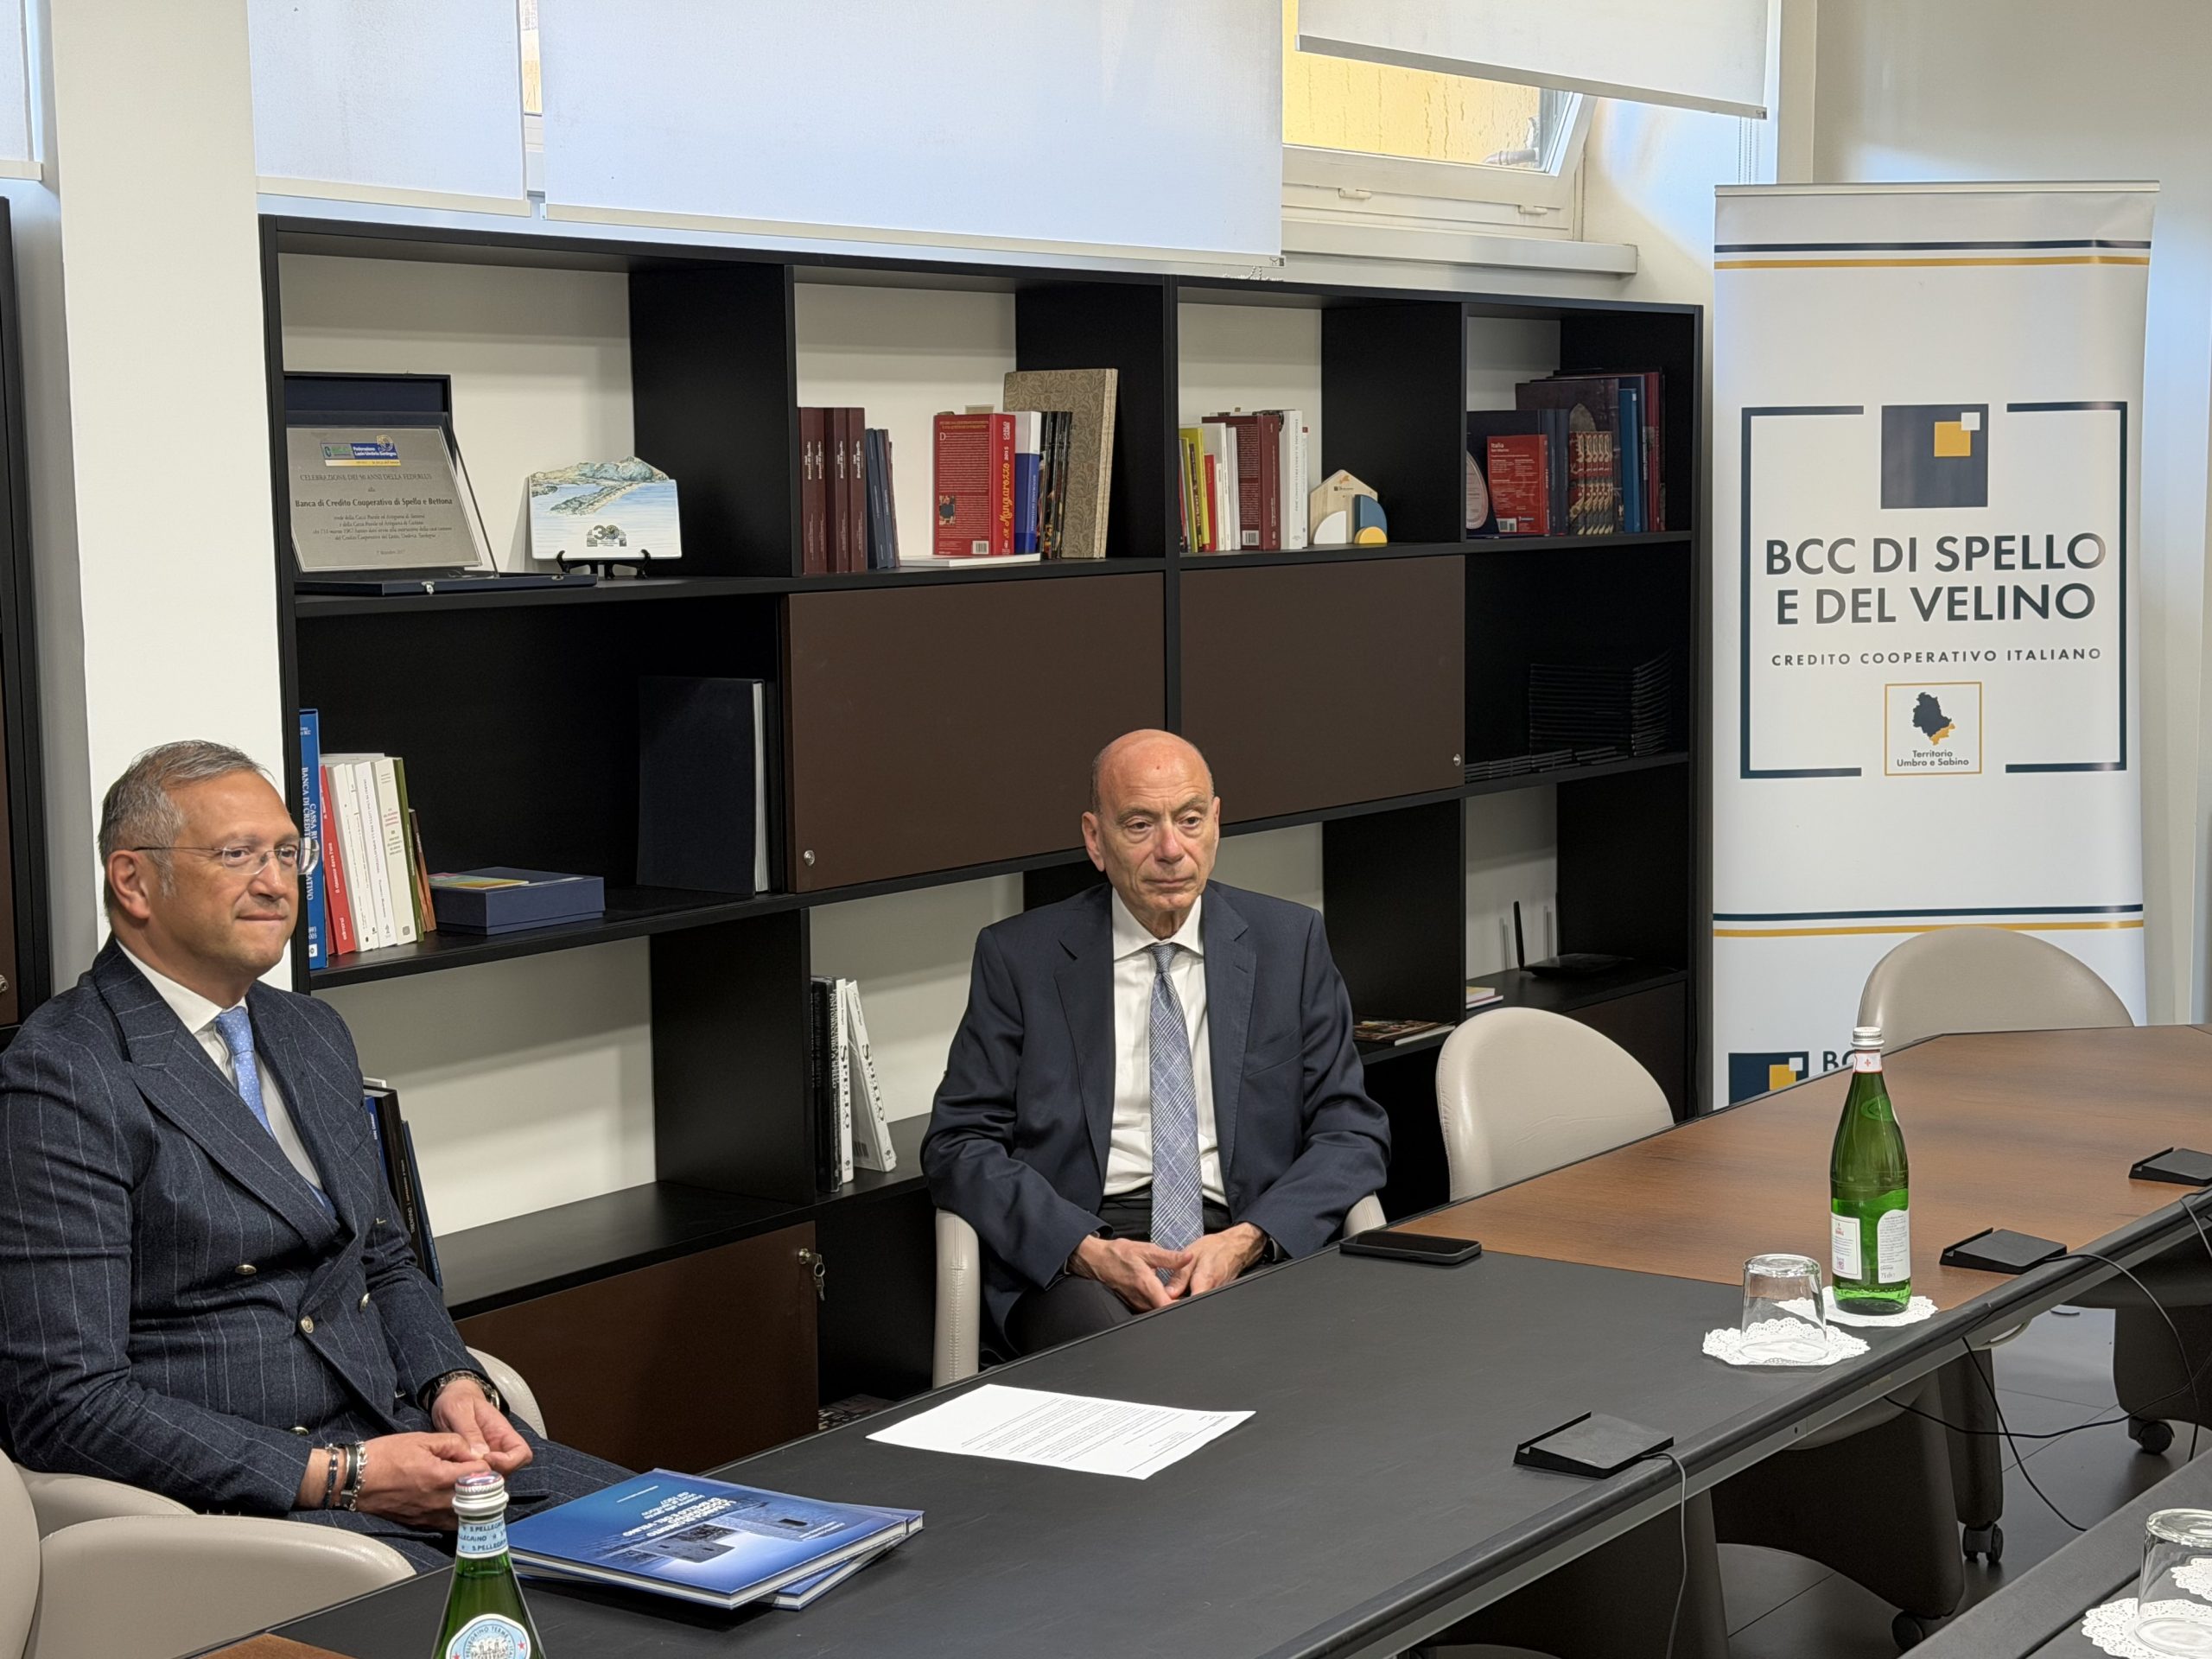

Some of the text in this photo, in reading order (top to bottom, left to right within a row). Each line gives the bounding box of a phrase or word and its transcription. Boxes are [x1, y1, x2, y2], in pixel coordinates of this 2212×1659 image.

[353, 498, 392, 508] Cooperativo
[402, 498, 422, 508] Spello
[1766, 533, 2106, 575] BCC DI SPELLO
[1777, 582, 2096, 625] E DEL VELINO
[1771, 648, 2101, 666] CREDITO COOPERATIVO ITALIANO
[1937, 757, 1969, 766] Sabino
[302, 797, 309, 805] DI
[840, 1046, 849, 1128] SPELLO
[862, 1044, 885, 1122] SPELLO
[622, 1522, 657, 1536] VELINO
